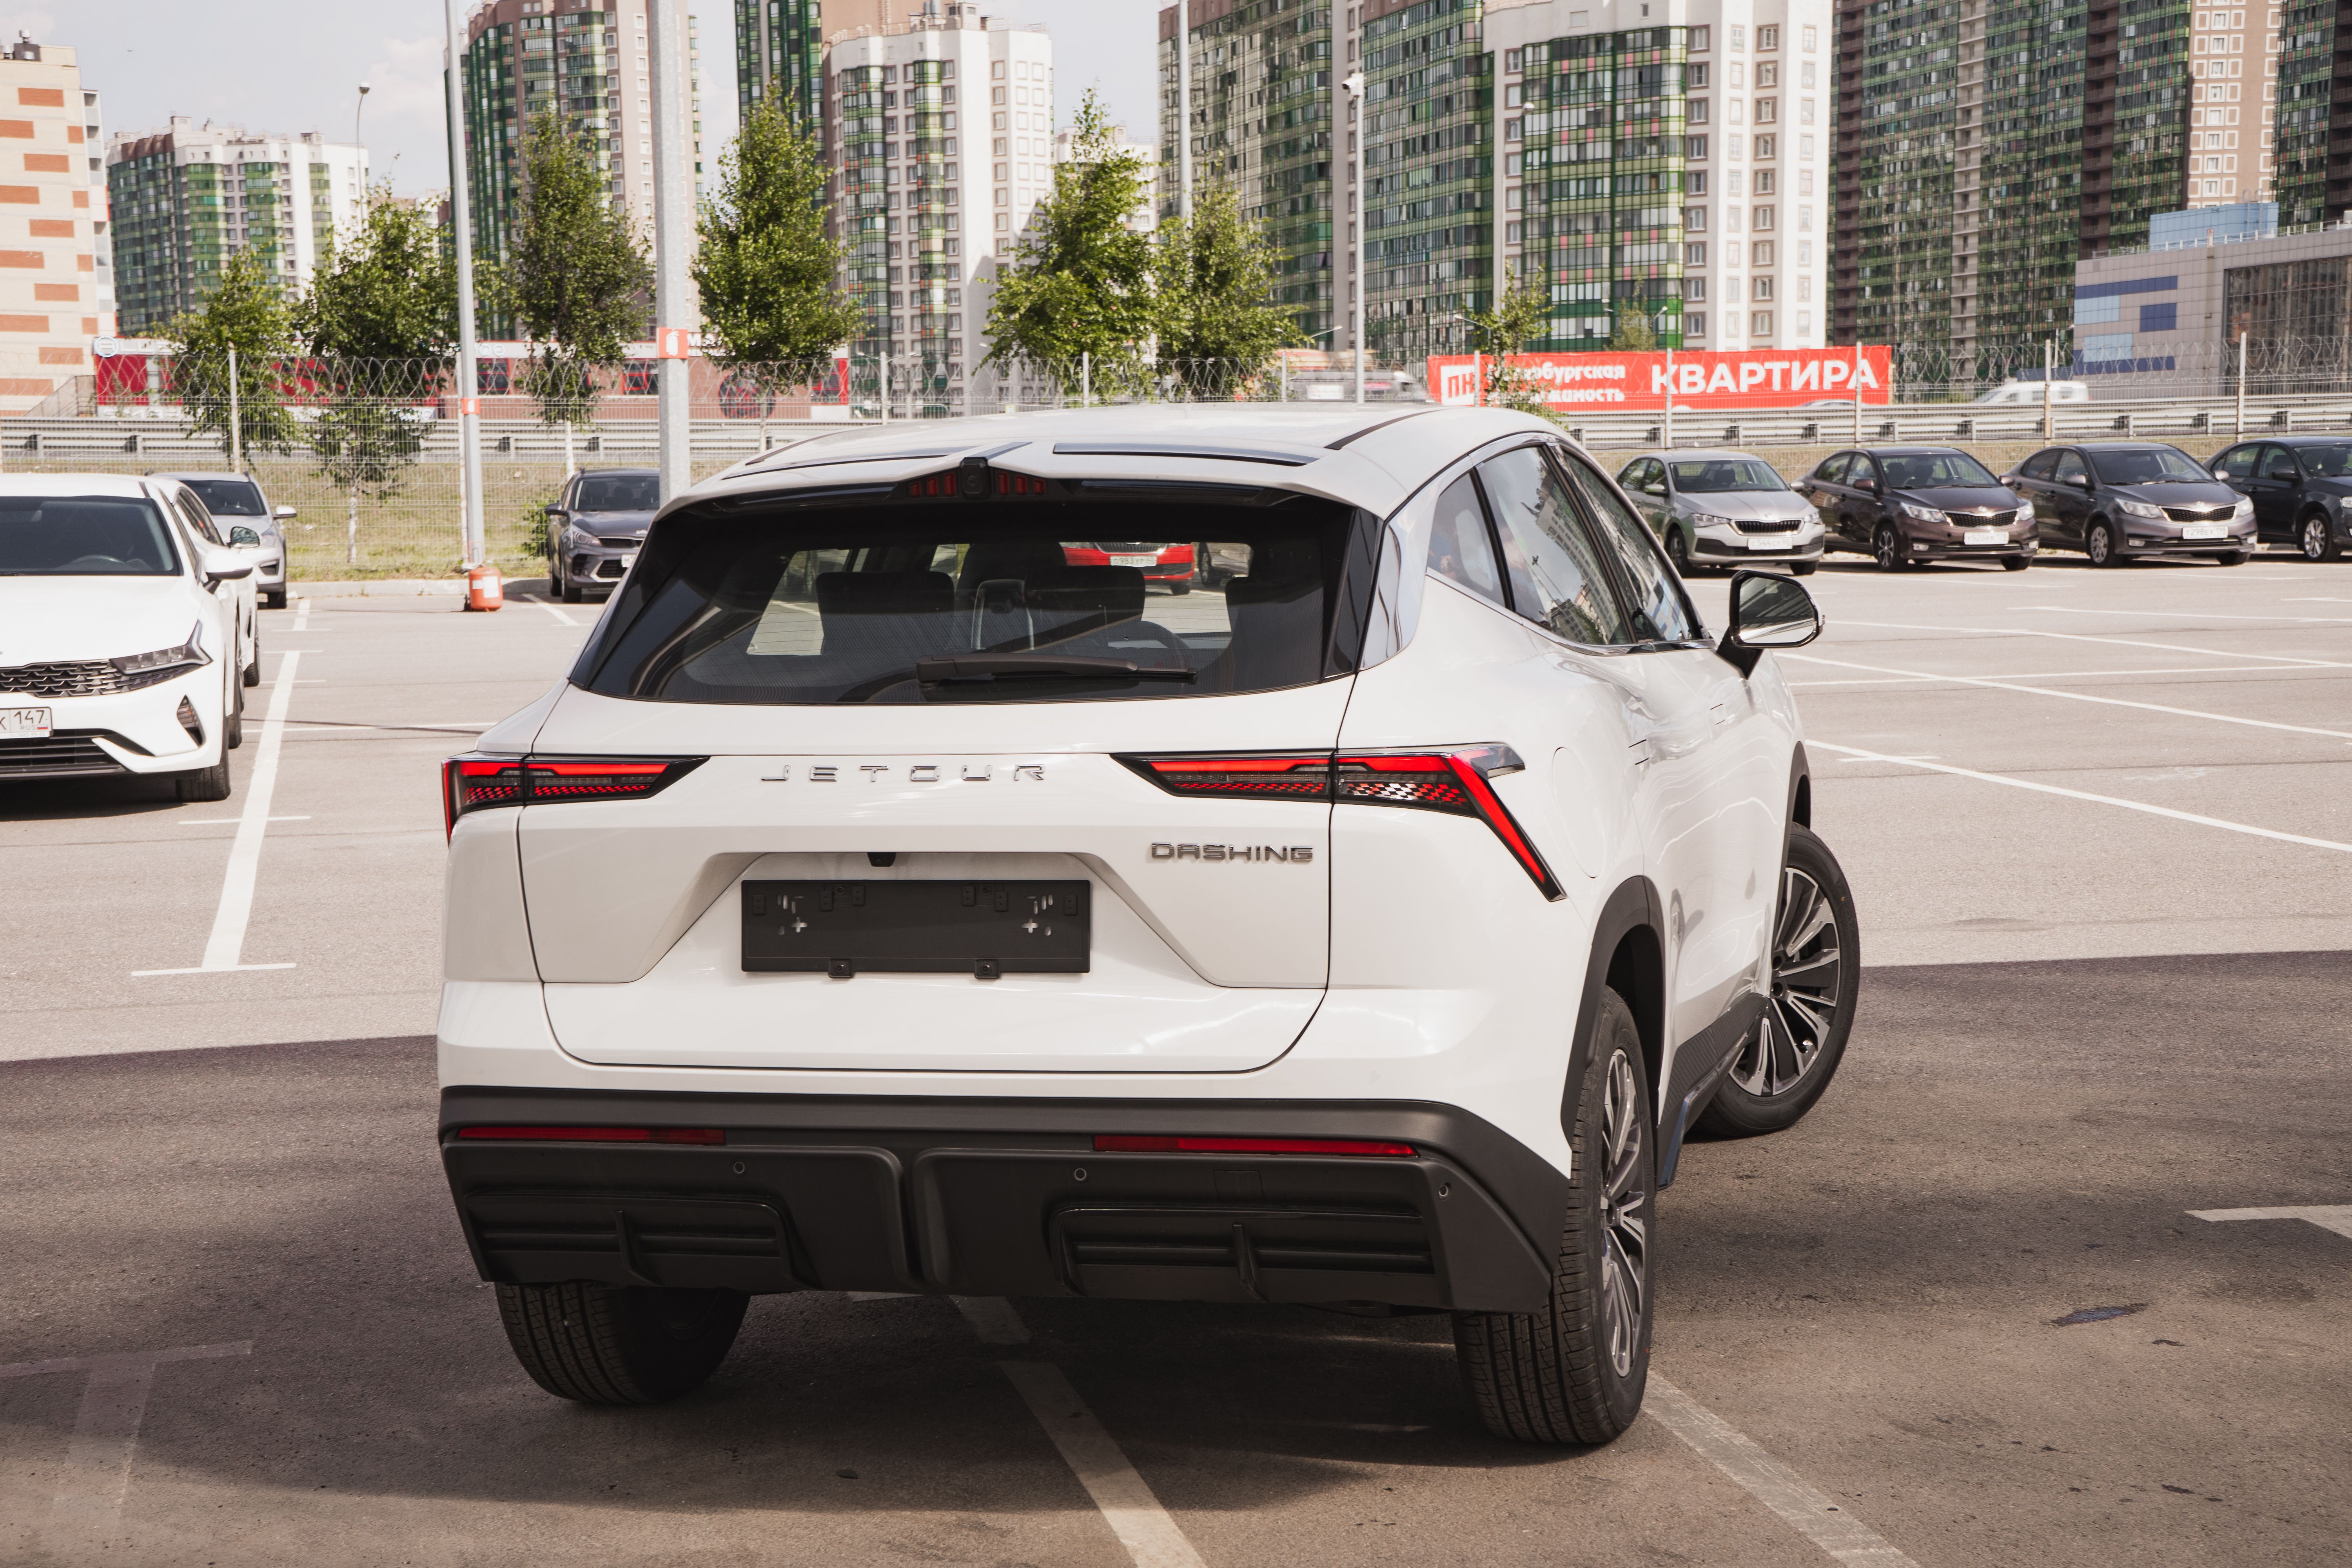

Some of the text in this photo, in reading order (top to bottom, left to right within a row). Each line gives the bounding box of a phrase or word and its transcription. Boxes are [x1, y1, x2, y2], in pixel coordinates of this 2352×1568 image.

[1651, 359, 1878, 394] КВАРТИРА
[13, 710, 45, 724] 147
[761, 765, 1045, 782] JETOUR
[1151, 842, 1314, 863] DASHING
